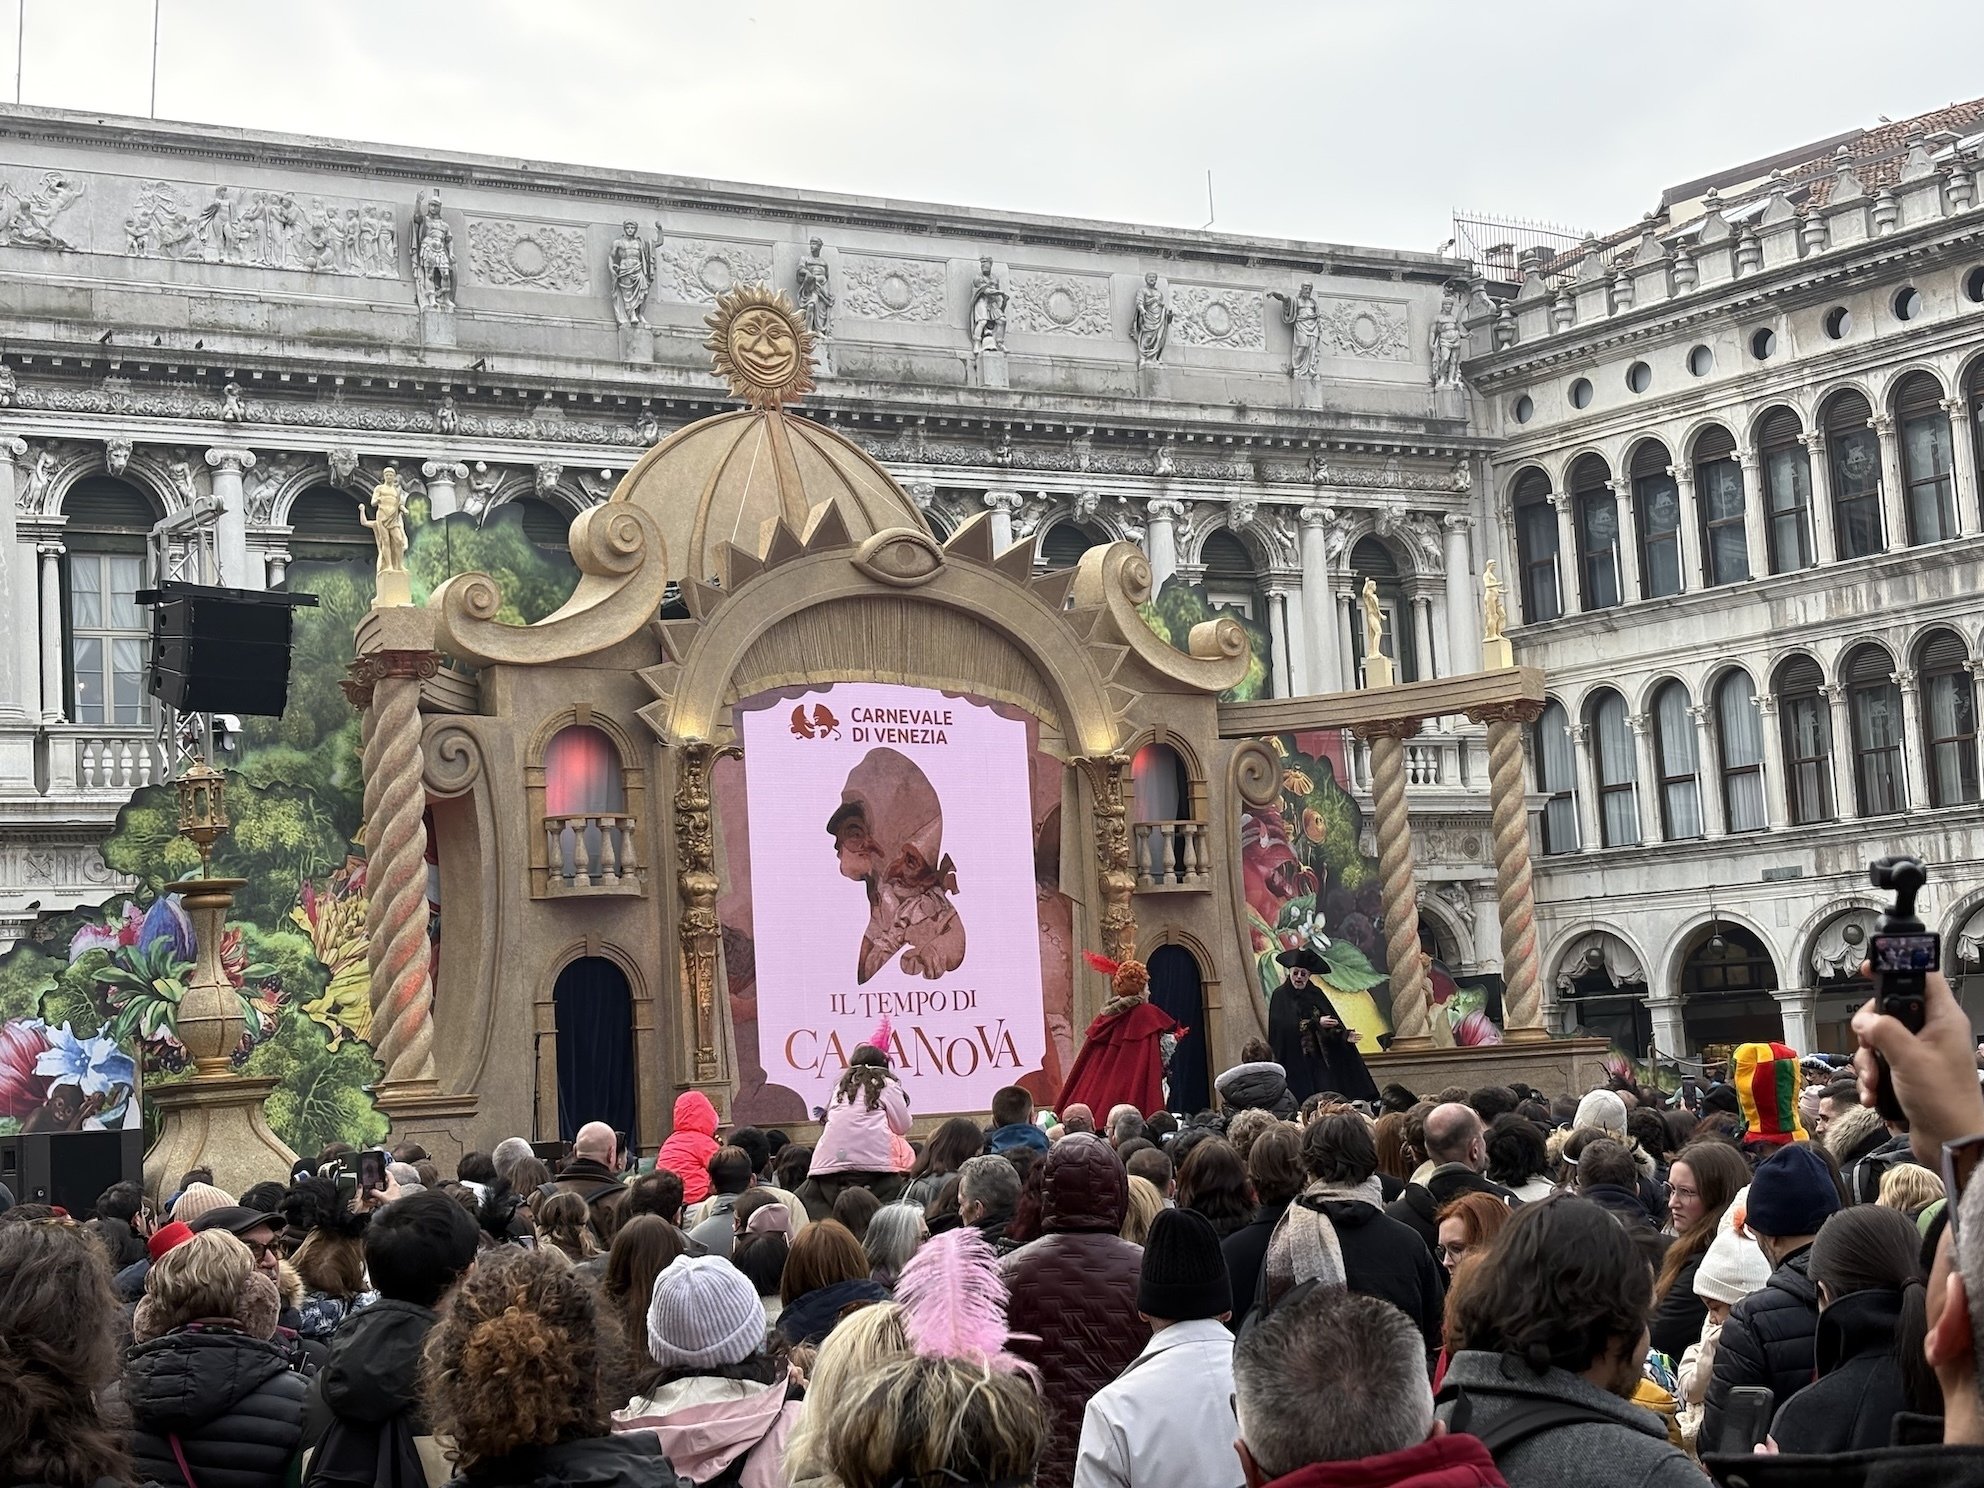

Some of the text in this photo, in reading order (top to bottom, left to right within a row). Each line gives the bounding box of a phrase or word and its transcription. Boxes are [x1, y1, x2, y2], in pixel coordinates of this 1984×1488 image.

[851, 707, 953, 725] CARNEVALE
[852, 727, 948, 745] DI VENEZIA
[830, 989, 977, 1018] IL TEMPO DI
[784, 1018, 1024, 1079] CAANOVA
